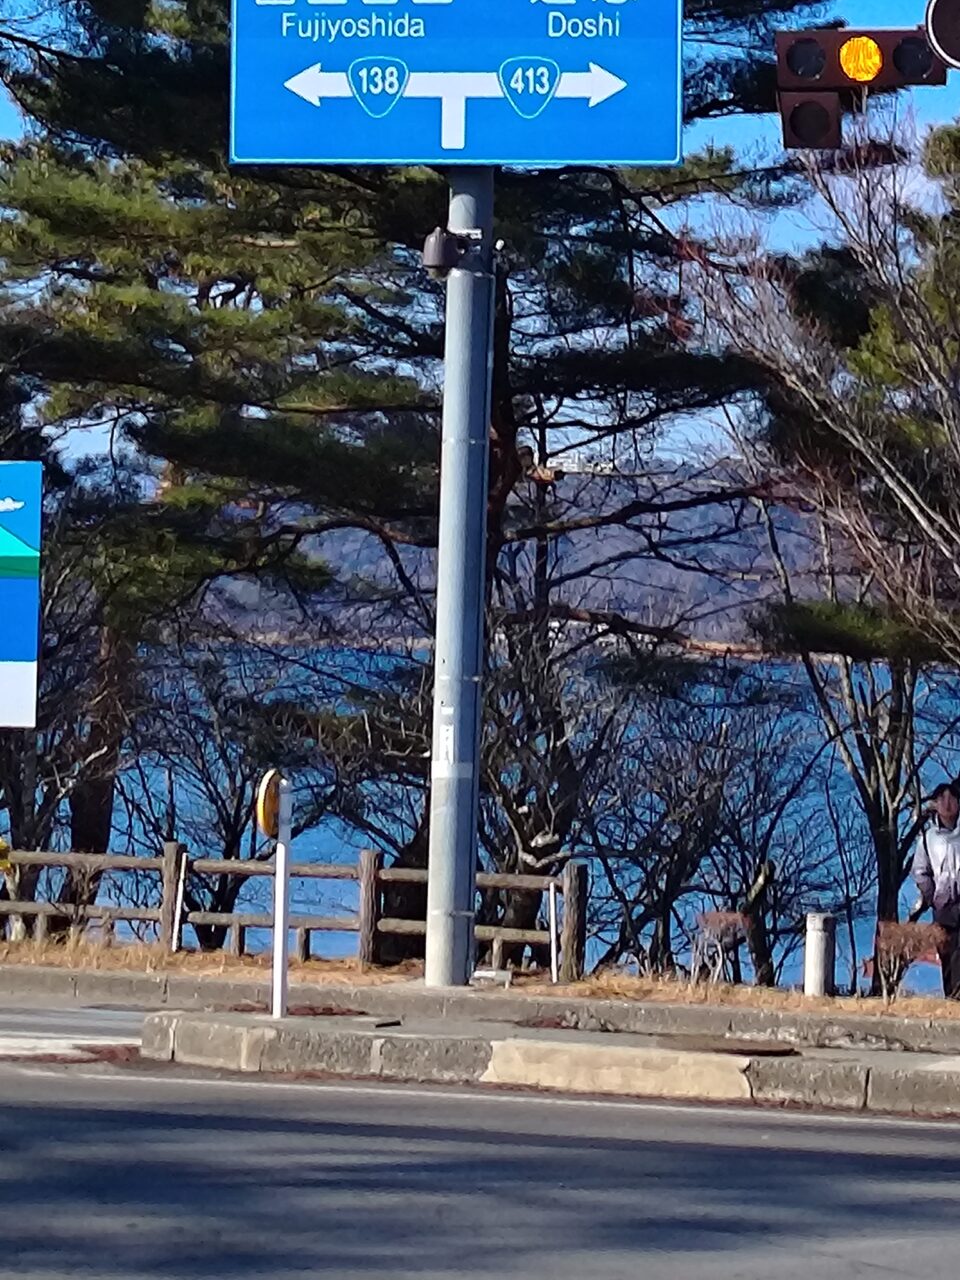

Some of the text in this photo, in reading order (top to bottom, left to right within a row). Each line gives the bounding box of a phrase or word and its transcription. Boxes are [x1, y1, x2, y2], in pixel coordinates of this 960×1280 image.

[281, 12, 425, 42] Fujiyoshida
[547, 11, 621, 38] Doshi
[358, 66, 399, 95] 138
[509, 66, 551, 95] 413
